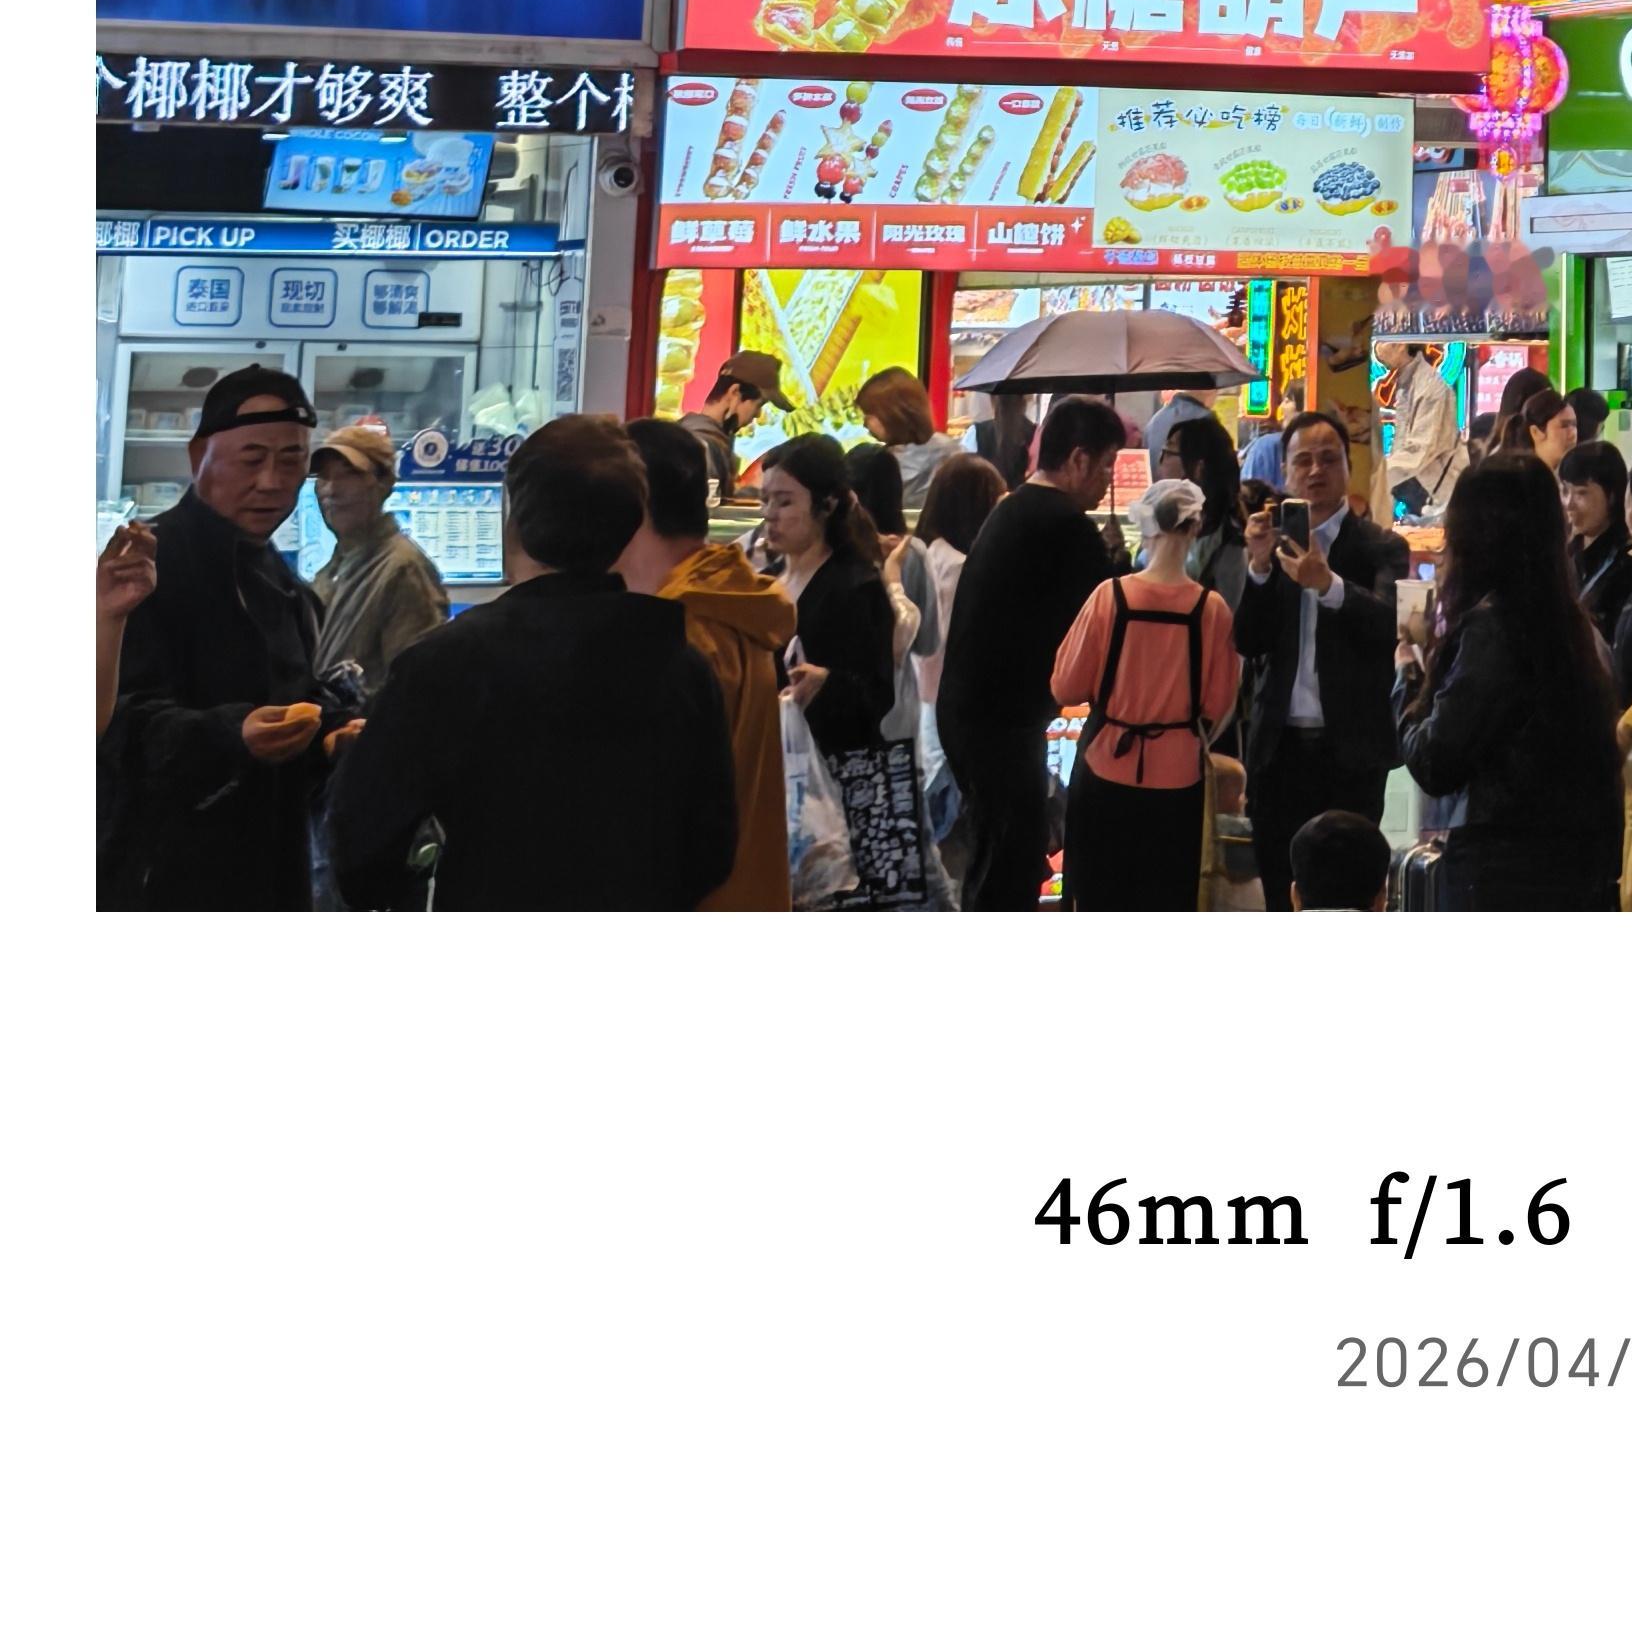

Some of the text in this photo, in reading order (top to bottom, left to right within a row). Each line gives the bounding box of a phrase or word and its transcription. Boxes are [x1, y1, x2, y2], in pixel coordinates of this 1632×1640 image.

[1116, 99, 1283, 132] 推荐必吃榜
[152, 226, 213, 248] PICK
[219, 227, 257, 249] UP
[331, 222, 510, 251] 买椰椰 ORDER
[670, 219, 756, 245] 鲜草莓
[779, 219, 862, 245] 鲜水果
[187, 278, 231, 301] 泰国
[281, 280, 325, 302] 现切
